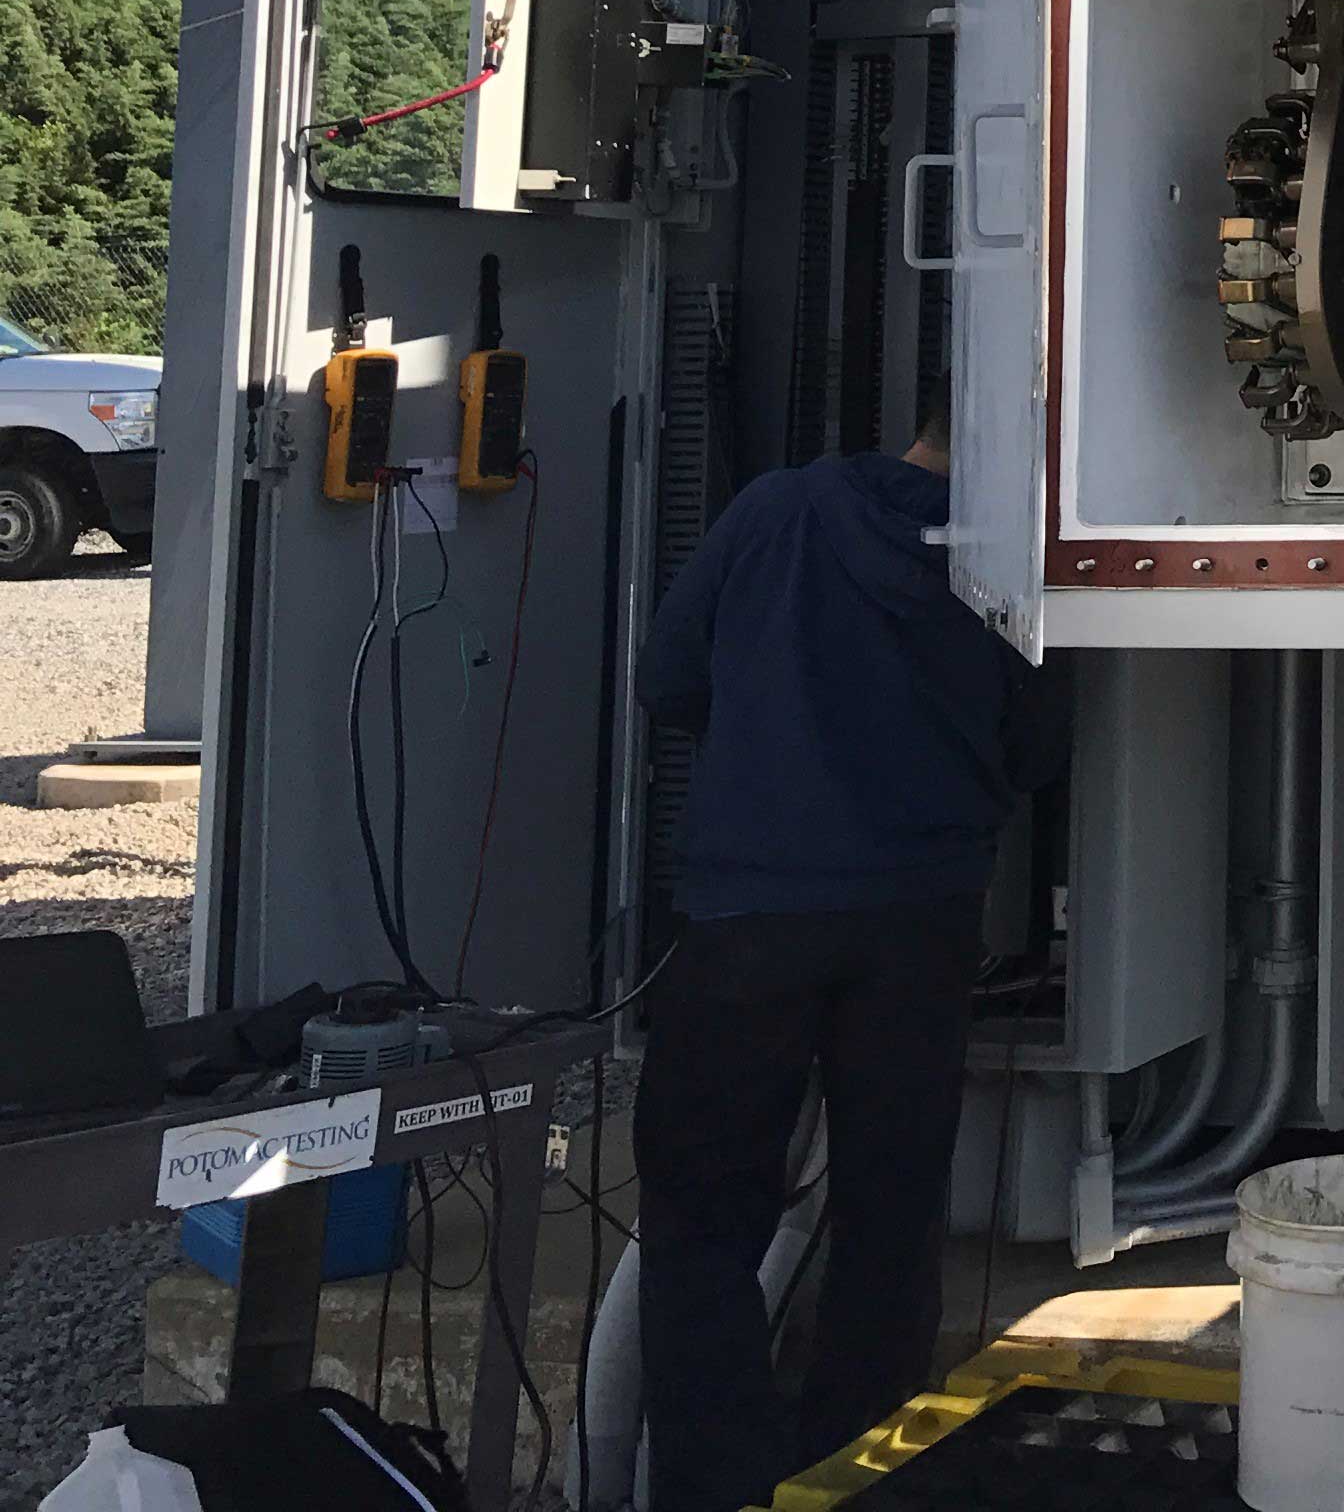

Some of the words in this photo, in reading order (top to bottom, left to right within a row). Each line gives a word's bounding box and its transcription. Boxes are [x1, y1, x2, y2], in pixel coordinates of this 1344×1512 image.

[398, 1108, 437, 1129] KEEP
[440, 1099, 481, 1120] WITH
[491, 1089, 529, 1109] IT-01
[168, 1137, 280, 1179] POTOMAC
[283, 1119, 370, 1155] TESTING
